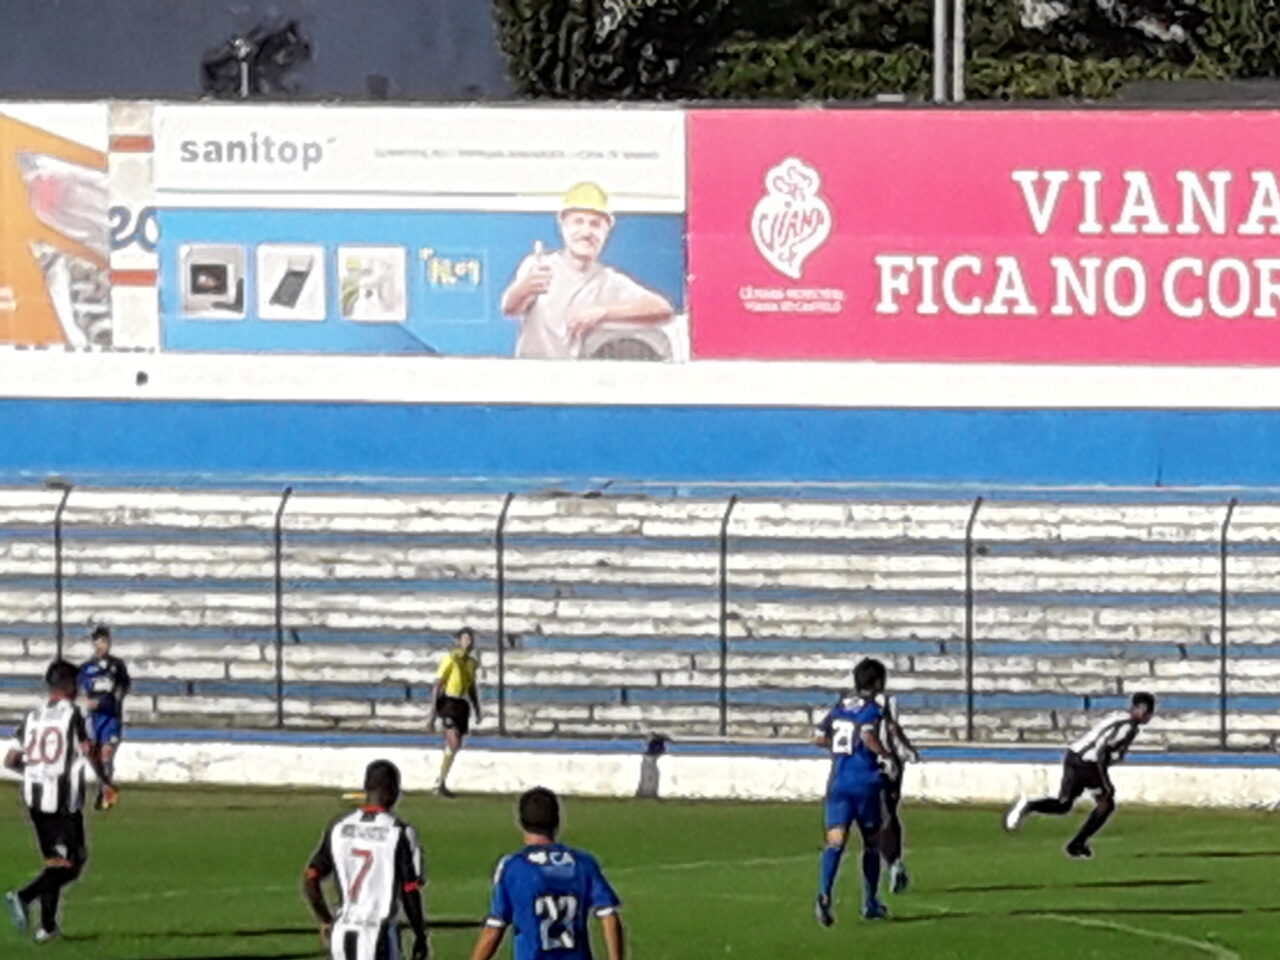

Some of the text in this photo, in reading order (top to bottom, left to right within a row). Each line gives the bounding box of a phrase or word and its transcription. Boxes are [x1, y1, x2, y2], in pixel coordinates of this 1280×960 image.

[180, 131, 323, 172] sanitop
[873, 254, 1038, 316] FICA
[1050, 256, 1148, 318] NO
[348, 848, 374, 903] 7
